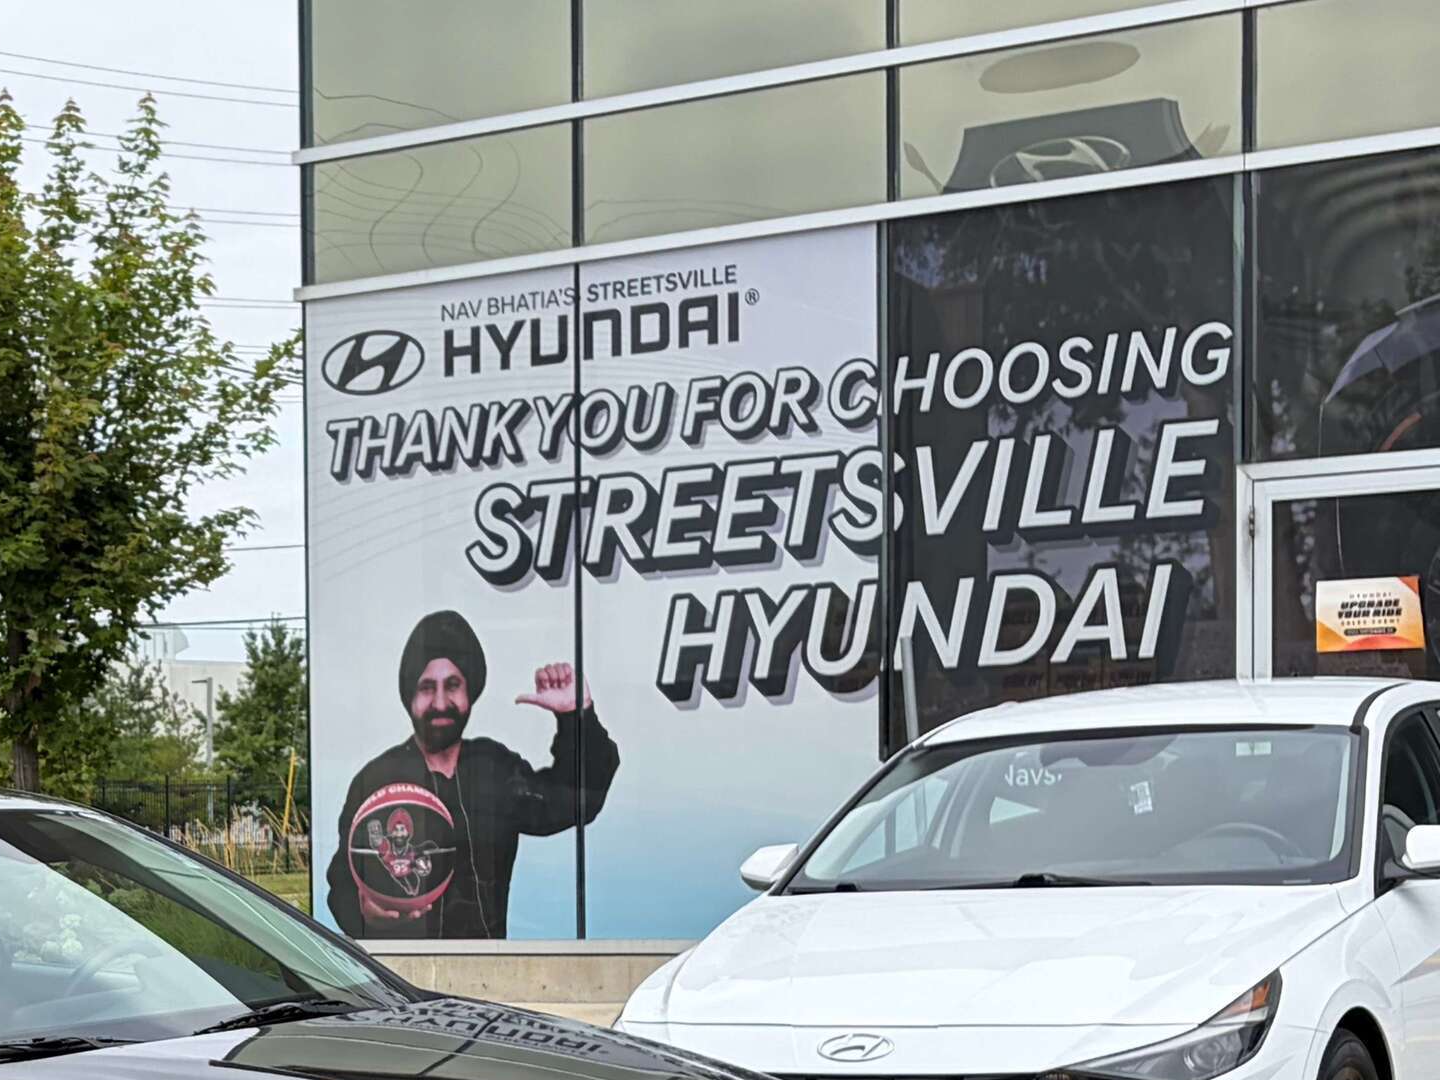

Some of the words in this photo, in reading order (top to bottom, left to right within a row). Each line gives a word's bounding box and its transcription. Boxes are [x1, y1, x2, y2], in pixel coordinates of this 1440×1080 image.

[441, 298, 483, 322] NAV
[487, 287, 577, 317] BHATIA'S
[586, 264, 737, 303] STREETSVILLE
[443, 291, 740, 378] HYUNDAI
[326, 398, 532, 484] THANK
[534, 382, 676, 463] YOU
[681, 366, 821, 447] FOR
[827, 320, 1234, 440] CHOOSING
[464, 417, 1222, 592] STREETSVILLE
[656, 562, 1194, 706] HYUNDAI
